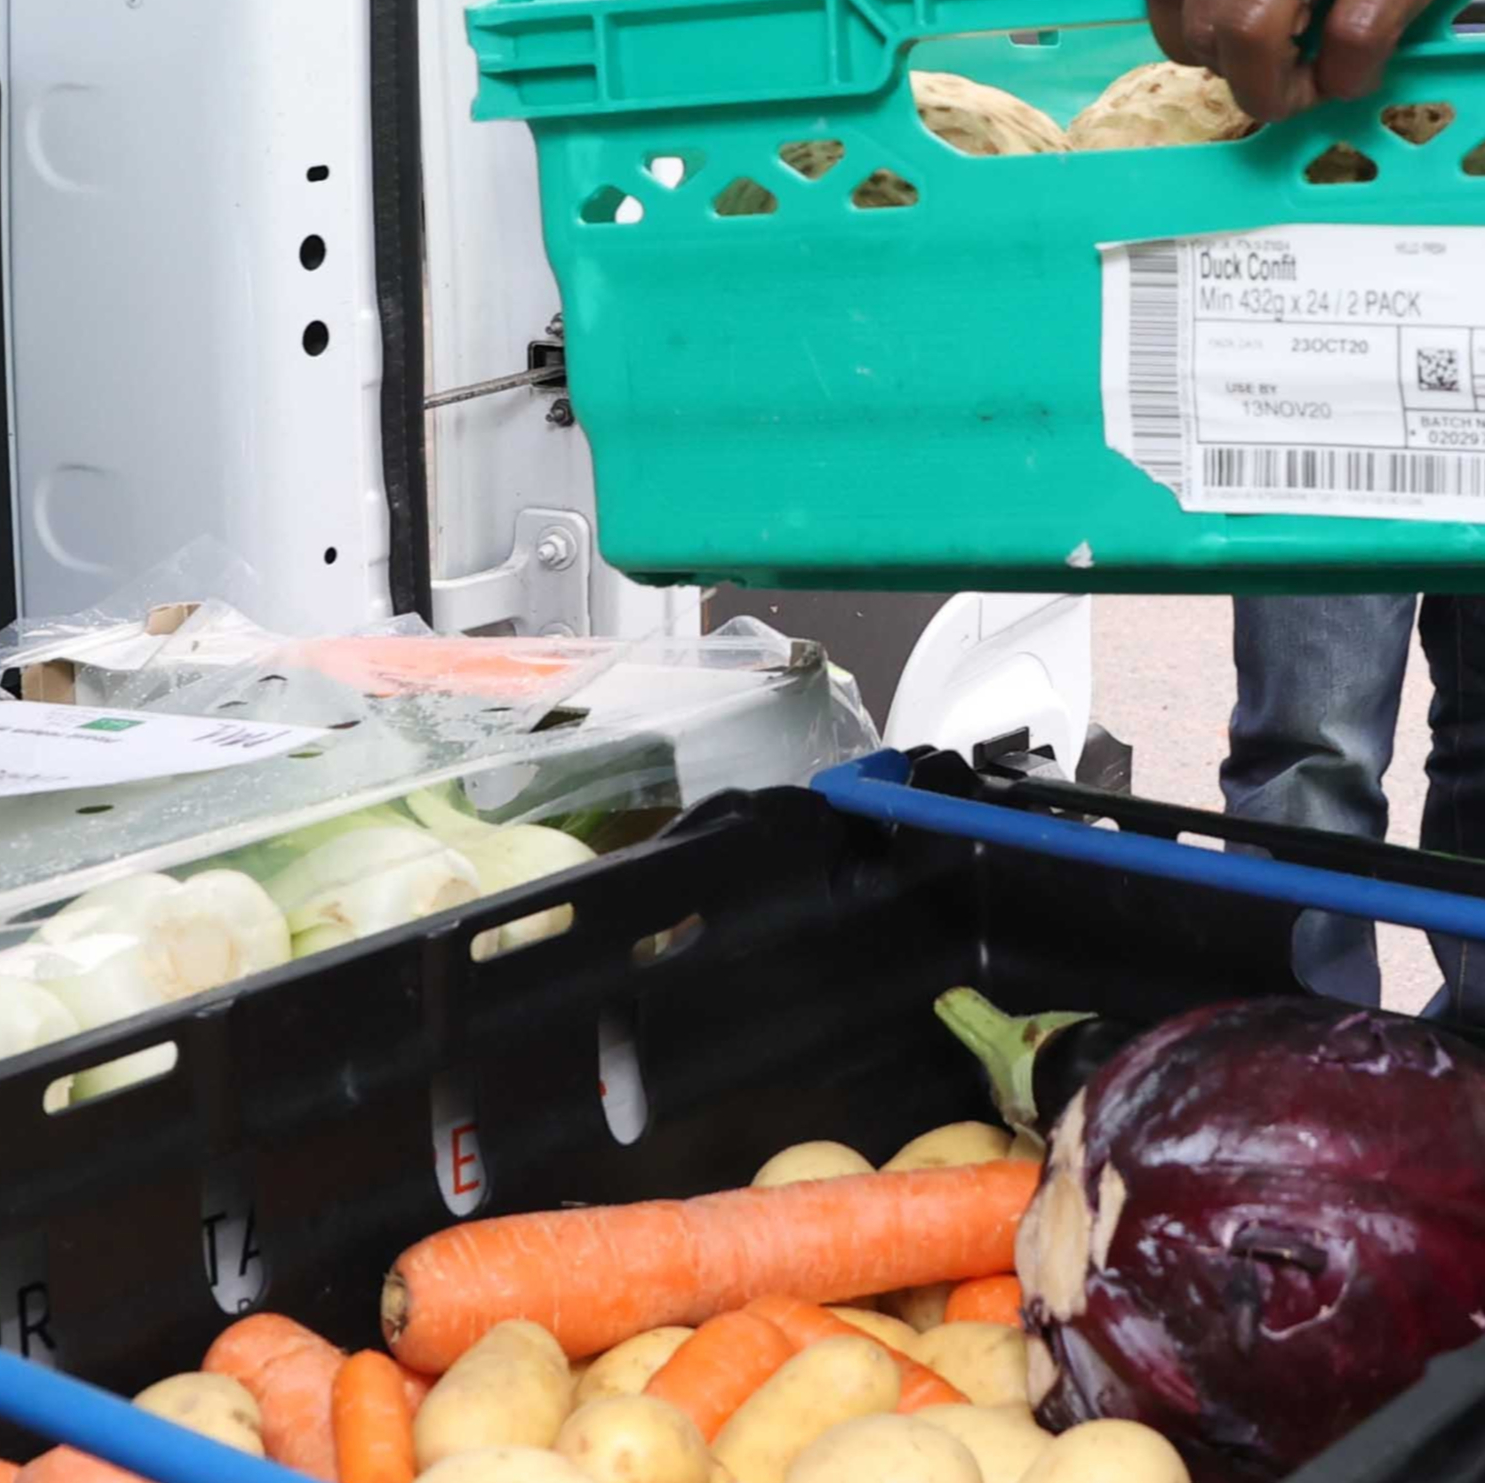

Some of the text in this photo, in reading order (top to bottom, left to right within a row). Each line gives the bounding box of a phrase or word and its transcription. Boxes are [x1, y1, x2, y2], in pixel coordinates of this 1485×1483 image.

[1200, 252, 1297, 281] Duck Confit
[1200, 287, 1423, 322] Min 432g x 24 / 2 PACK
[1290, 338, 1369, 354] 23OCT20
[1226, 383, 1278, 394] USE BY
[1243, 400, 1332, 419] 13NOV20
[1420, 416, 1472, 429] BATCH
